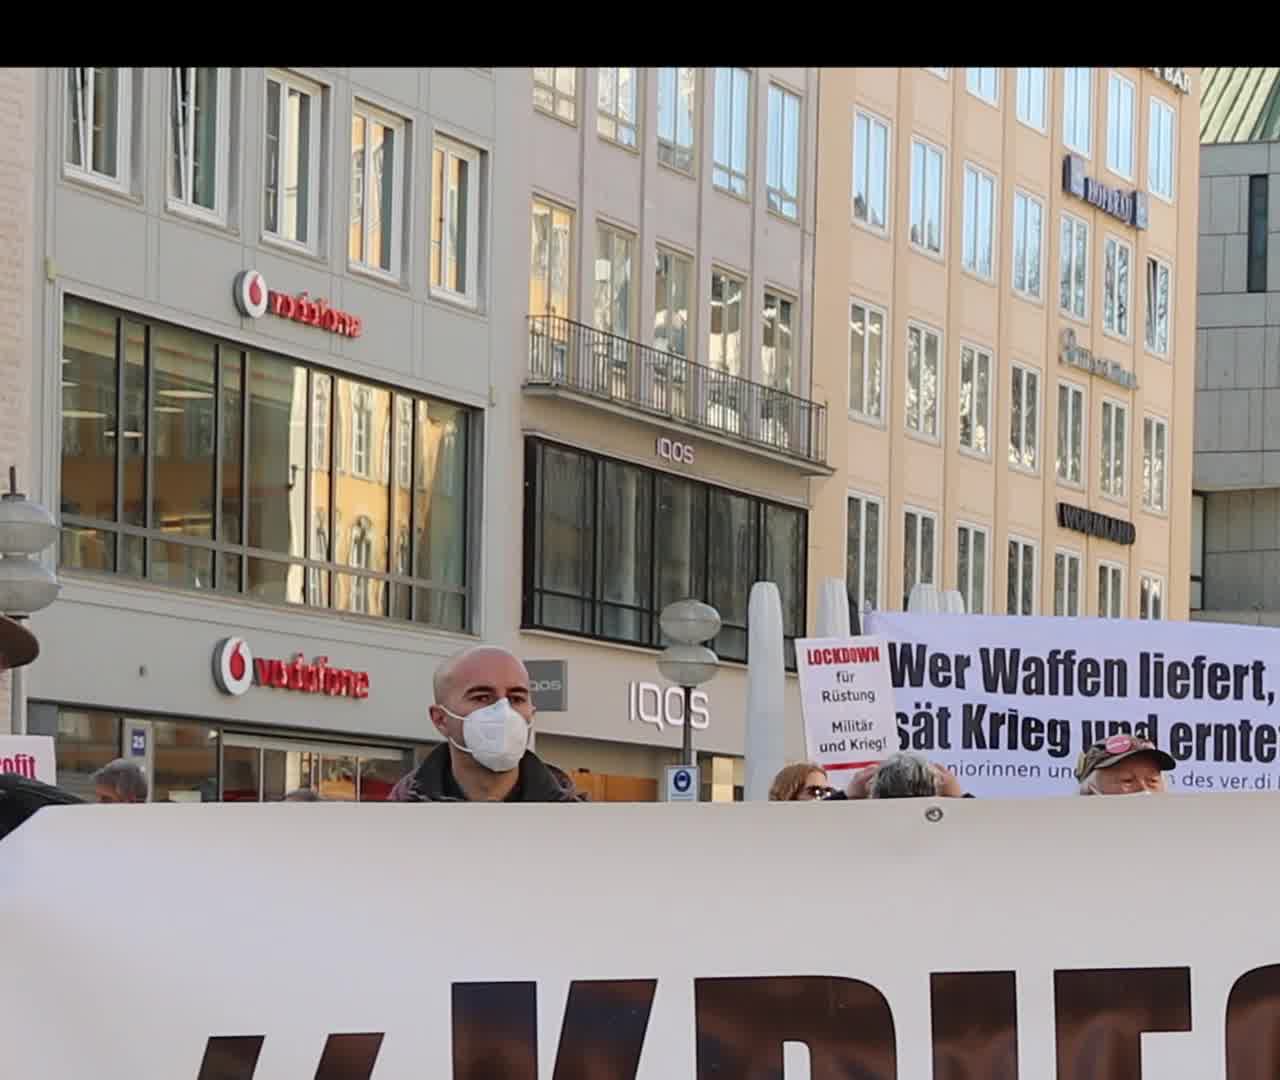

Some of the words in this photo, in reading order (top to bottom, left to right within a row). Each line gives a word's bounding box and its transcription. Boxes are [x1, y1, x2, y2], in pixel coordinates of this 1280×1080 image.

[656, 436, 696, 464] IQOS
[807, 646, 880, 666] LOCKDOWN
[253, 651, 369, 699] vodafone
[529, 679, 561, 691] QOS
[836, 670, 855, 683] für
[888, 642, 971, 689] Wer
[979, 647, 1128, 697] Waffen
[1139, 652, 1275, 706] liefert,
[629, 680, 709, 732] IQOS
[821, 689, 876, 704] Rüstung
[831, 719, 874, 734] Militär
[895, 702, 951, 751] sät
[962, 703, 1070, 758] Krieg
[820, 740, 846, 752] und
[850, 737, 888, 753] Krieg!
[948, 760, 1041, 779] niorinnen
[1182, 771, 1213, 789] des
[1220, 771, 1271, 790] ver.di
